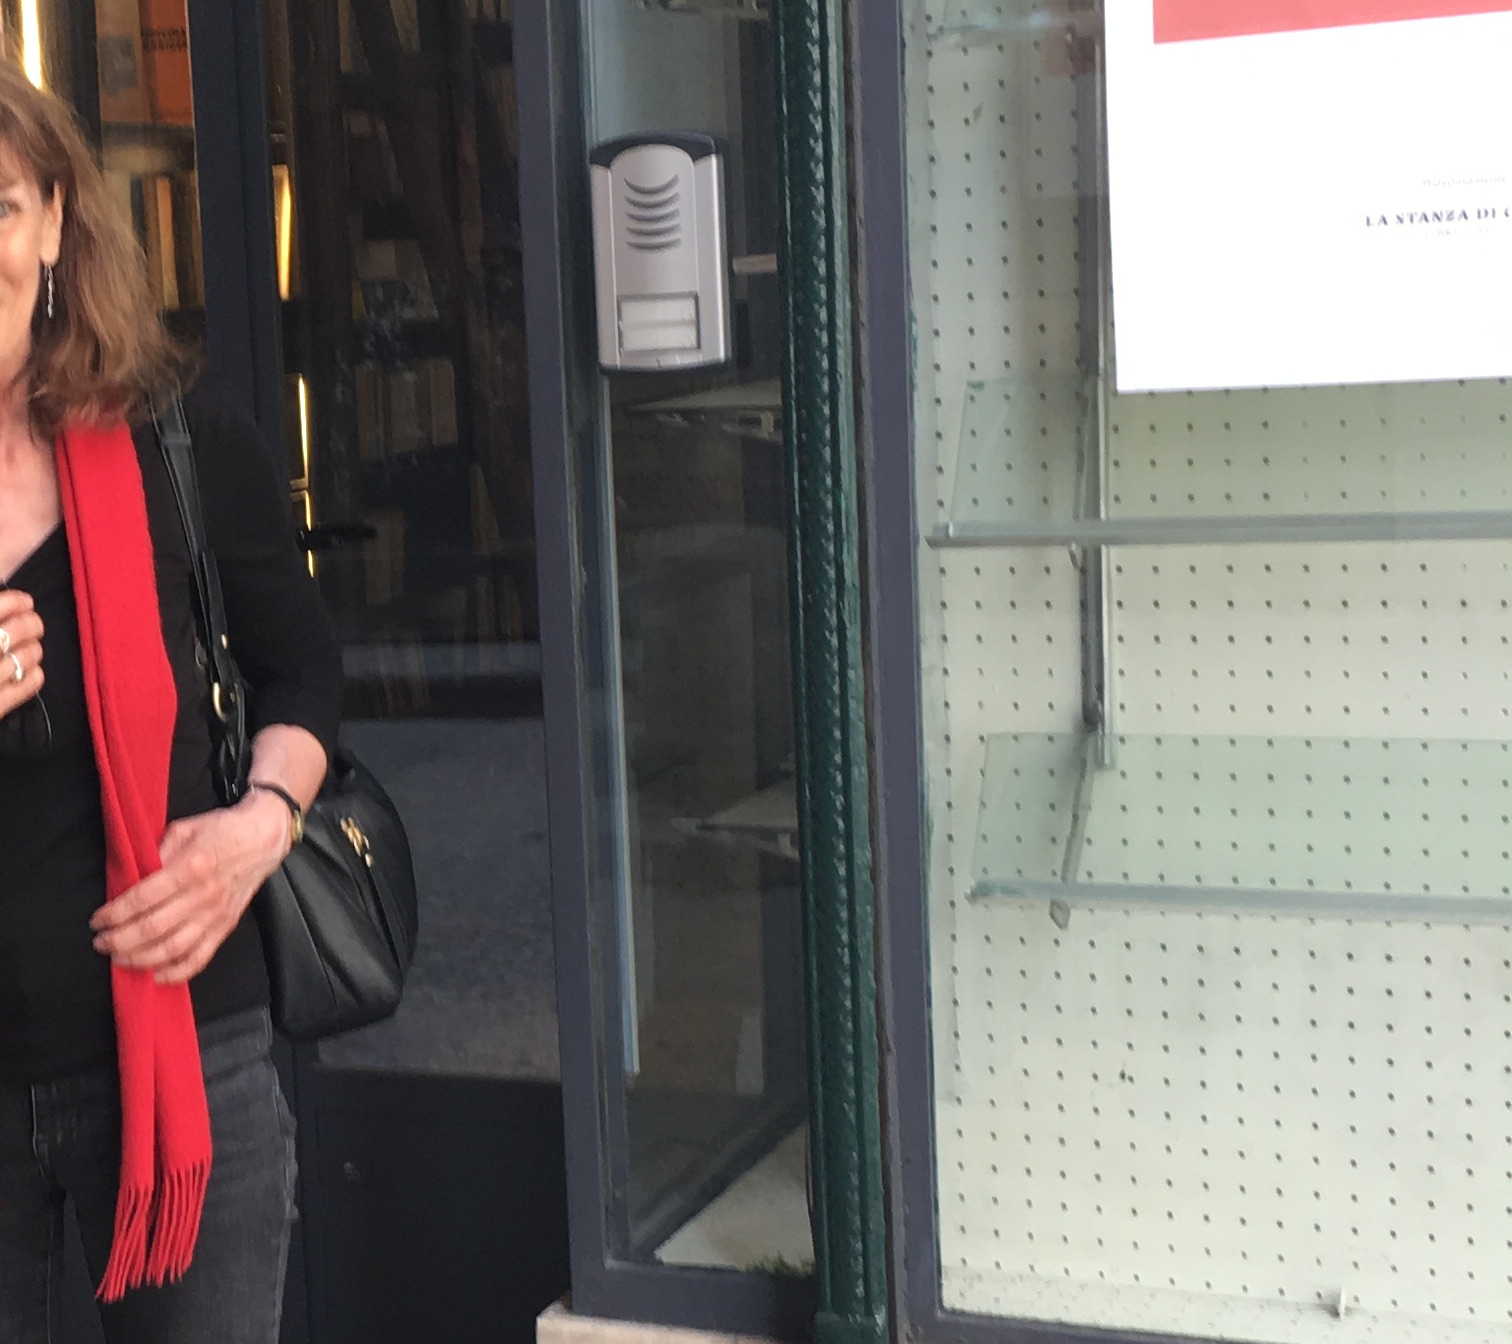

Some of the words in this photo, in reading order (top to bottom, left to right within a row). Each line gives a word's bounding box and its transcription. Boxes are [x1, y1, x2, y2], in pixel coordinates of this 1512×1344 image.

[1365, 214, 1388, 228] LA
[1395, 209, 1469, 225] STANZA
[1476, 207, 1497, 220] DI
